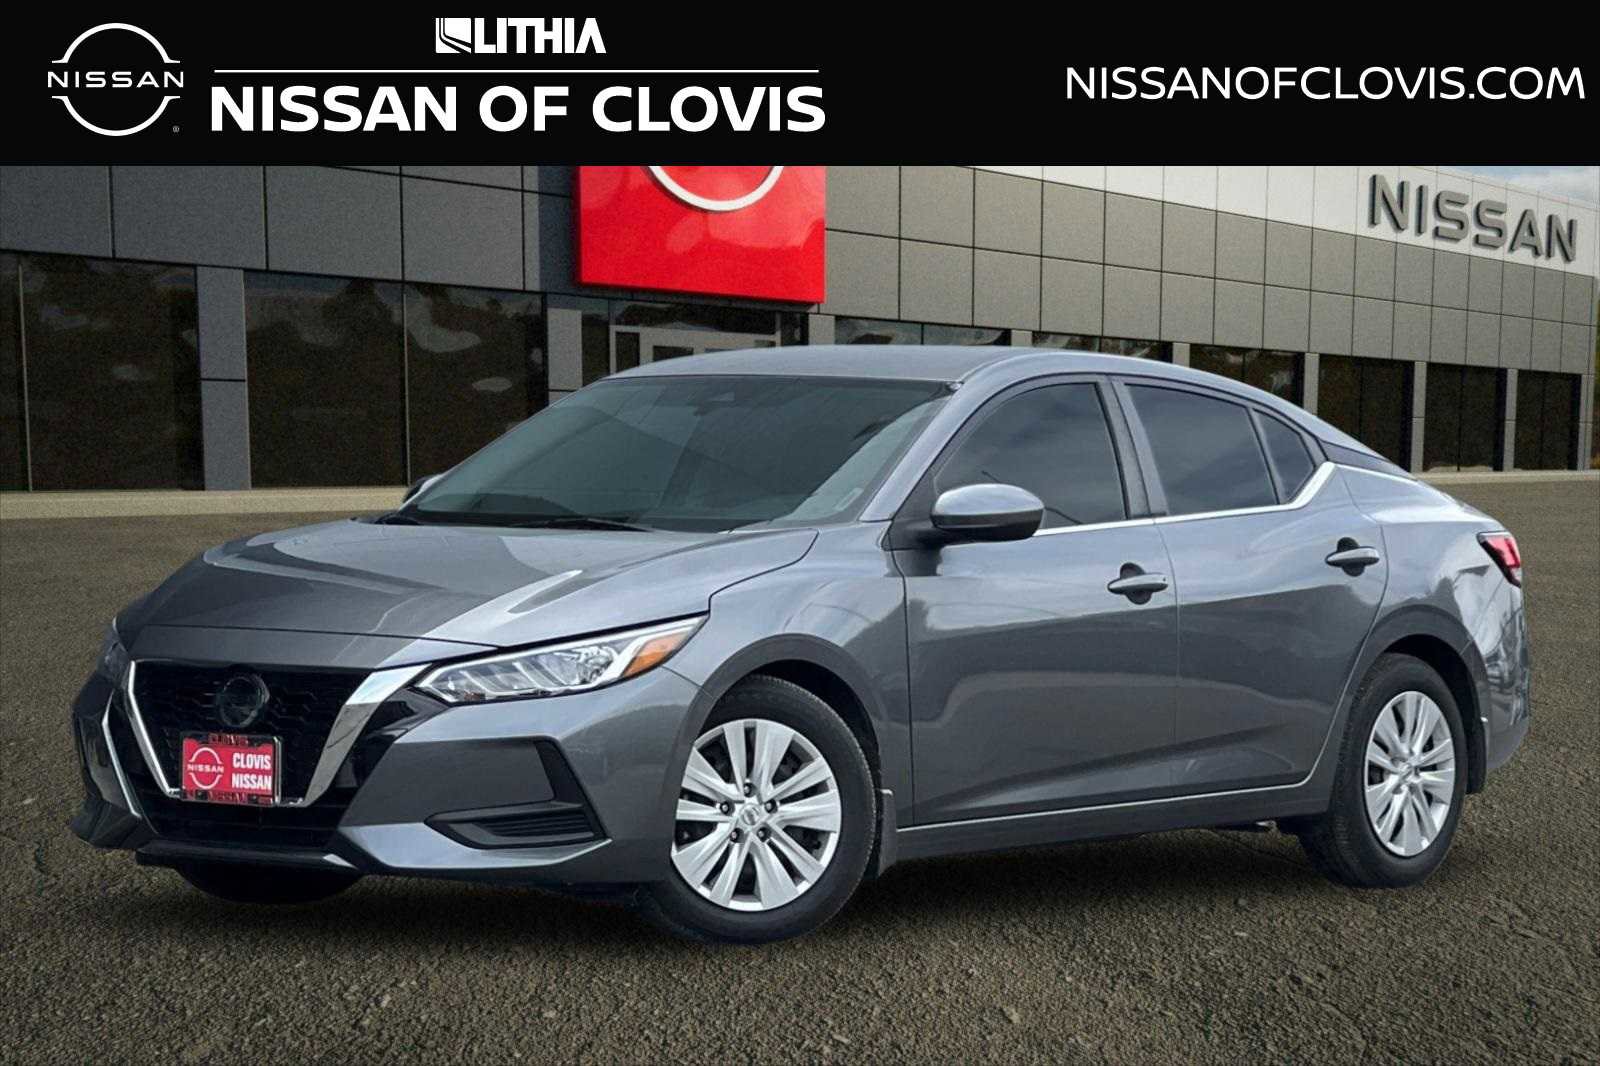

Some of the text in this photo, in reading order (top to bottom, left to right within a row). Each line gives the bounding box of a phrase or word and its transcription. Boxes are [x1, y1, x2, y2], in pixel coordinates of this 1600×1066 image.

[1367, 173, 1578, 263] NISSAN
[187, 763, 225, 774] NISSAN
[232, 752, 272, 769] CLOVIS
[231, 773, 272, 790] NISSAN
